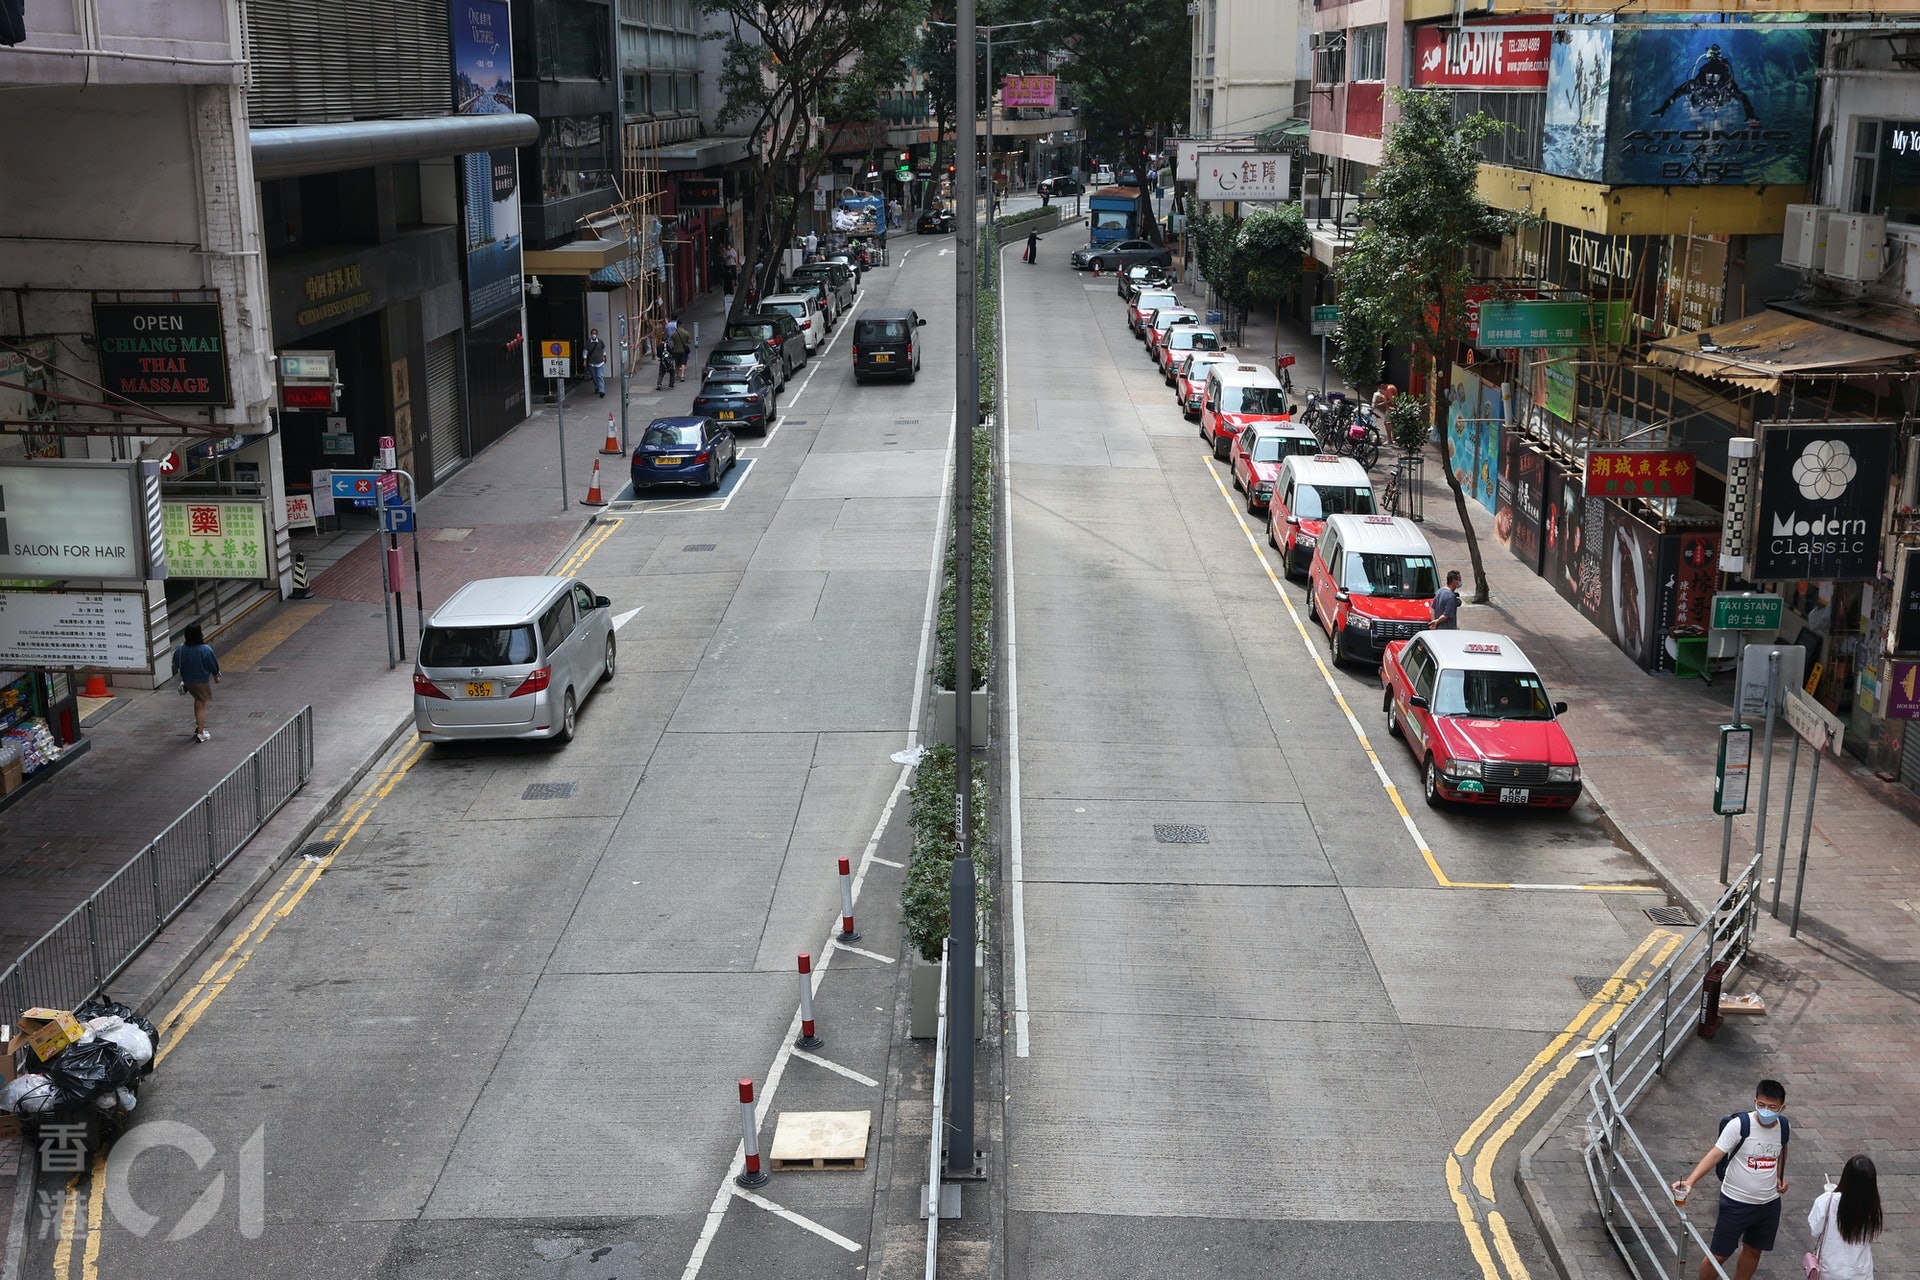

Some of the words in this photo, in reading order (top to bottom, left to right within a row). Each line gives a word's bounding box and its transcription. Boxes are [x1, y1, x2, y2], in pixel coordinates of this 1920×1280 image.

[1623, 130, 1792, 141] ATOMIC
[1892, 130, 1908, 156] My
[1621, 143, 1793, 154] AQUATICS
[1660, 162, 1744, 178] BARE
[1568, 234, 1632, 279] KINLAND
[133, 315, 184, 332] OPEN
[102, 336, 178, 354] CHIANG
[181, 337, 219, 352] MAI
[139, 357, 186, 374] THAI
[286, 360, 298, 374] P
[120, 377, 210, 394] MASSAGE
[1591, 456, 1692, 477] 潮城魚蛋粉
[190, 507, 218, 533] 藥
[288, 512, 310, 520] FULL
[391, 510, 407, 530] P
[1772, 511, 1866, 536] Modern
[14, 544, 60, 558] SALON
[63, 545, 91, 558] FOR
[95, 546, 126, 558] HAIR
[1771, 538, 1864, 555] Classic
[1720, 602, 1741, 610] TAXI
[1744, 602, 1778, 611] STAND
[1728, 614, 1767, 625] 的士站
[1468, 644, 1499, 652] TAXI
[1502, 795, 1527, 803] 3968
[956, 843, 962, 852] A
